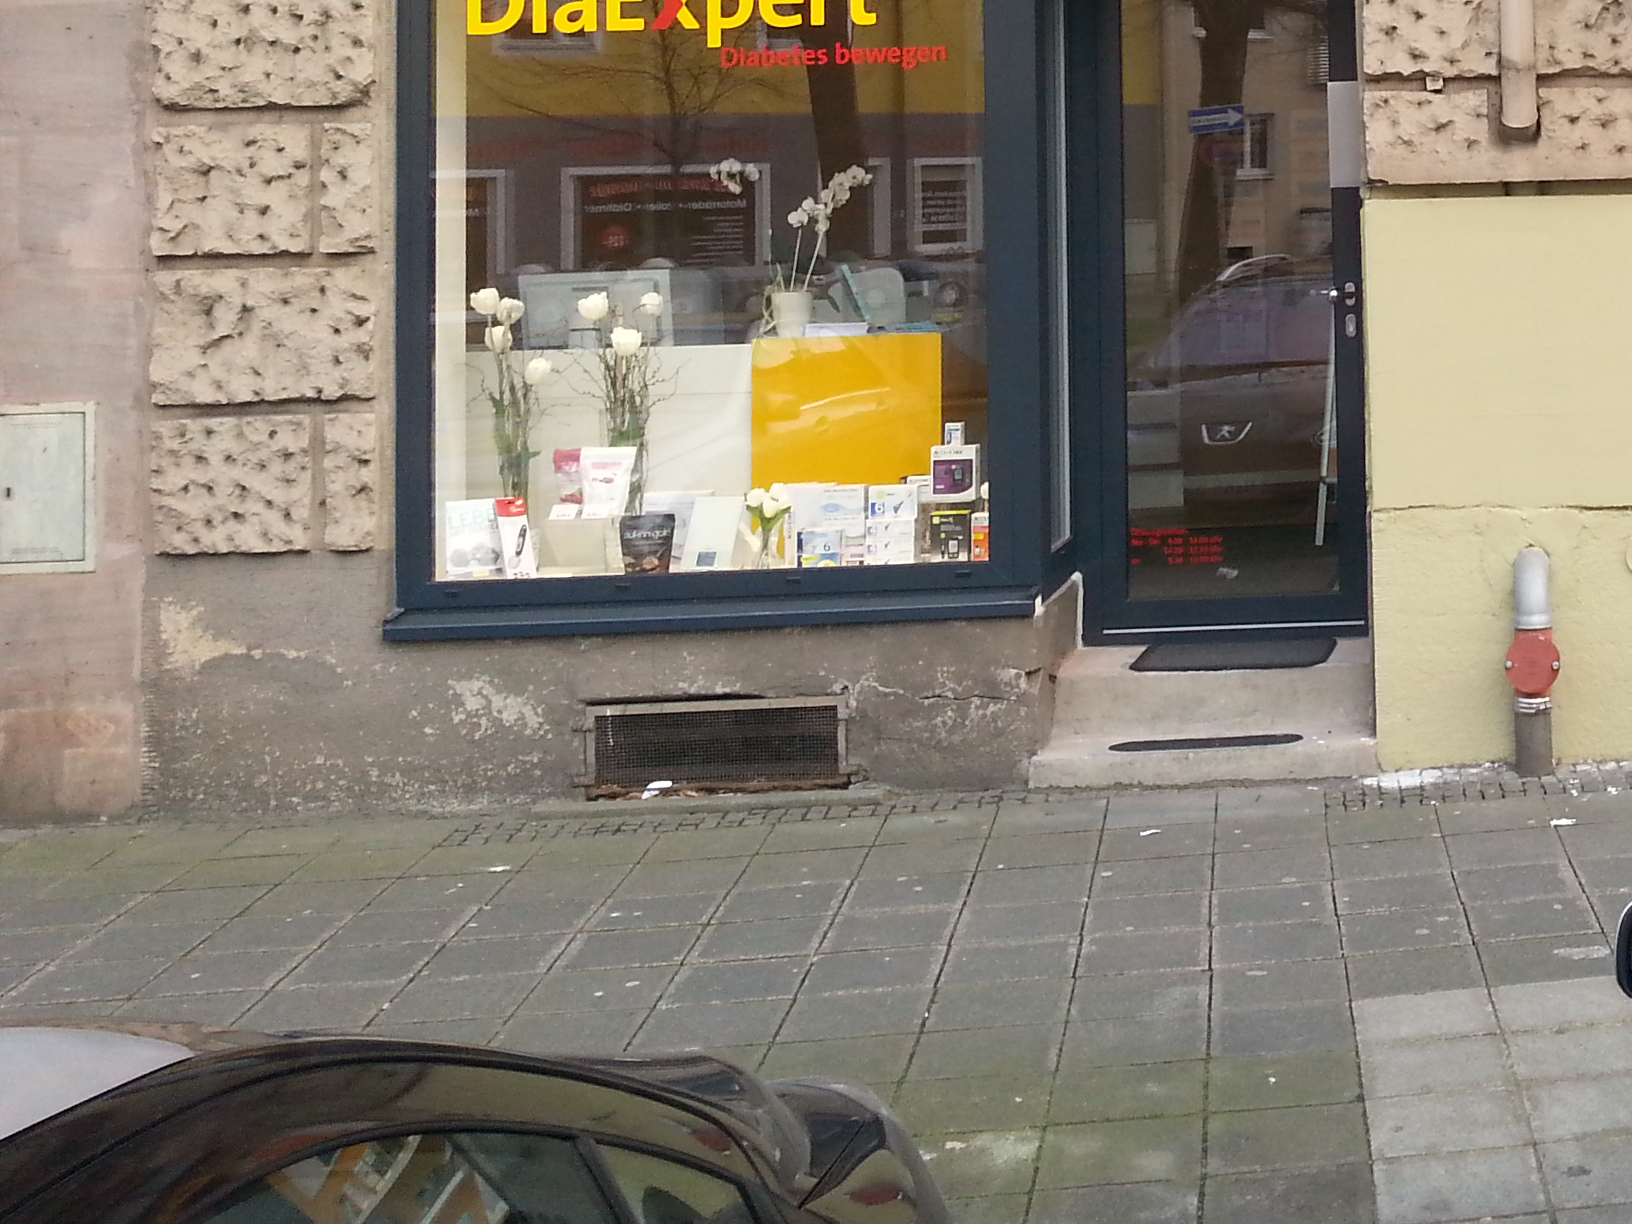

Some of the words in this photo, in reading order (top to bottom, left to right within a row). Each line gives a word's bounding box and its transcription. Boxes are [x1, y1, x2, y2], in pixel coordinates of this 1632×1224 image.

[720, 44, 828, 69] Diabetes
[835, 42, 948, 70] bewegen
[448, 507, 496, 530] LEBE
